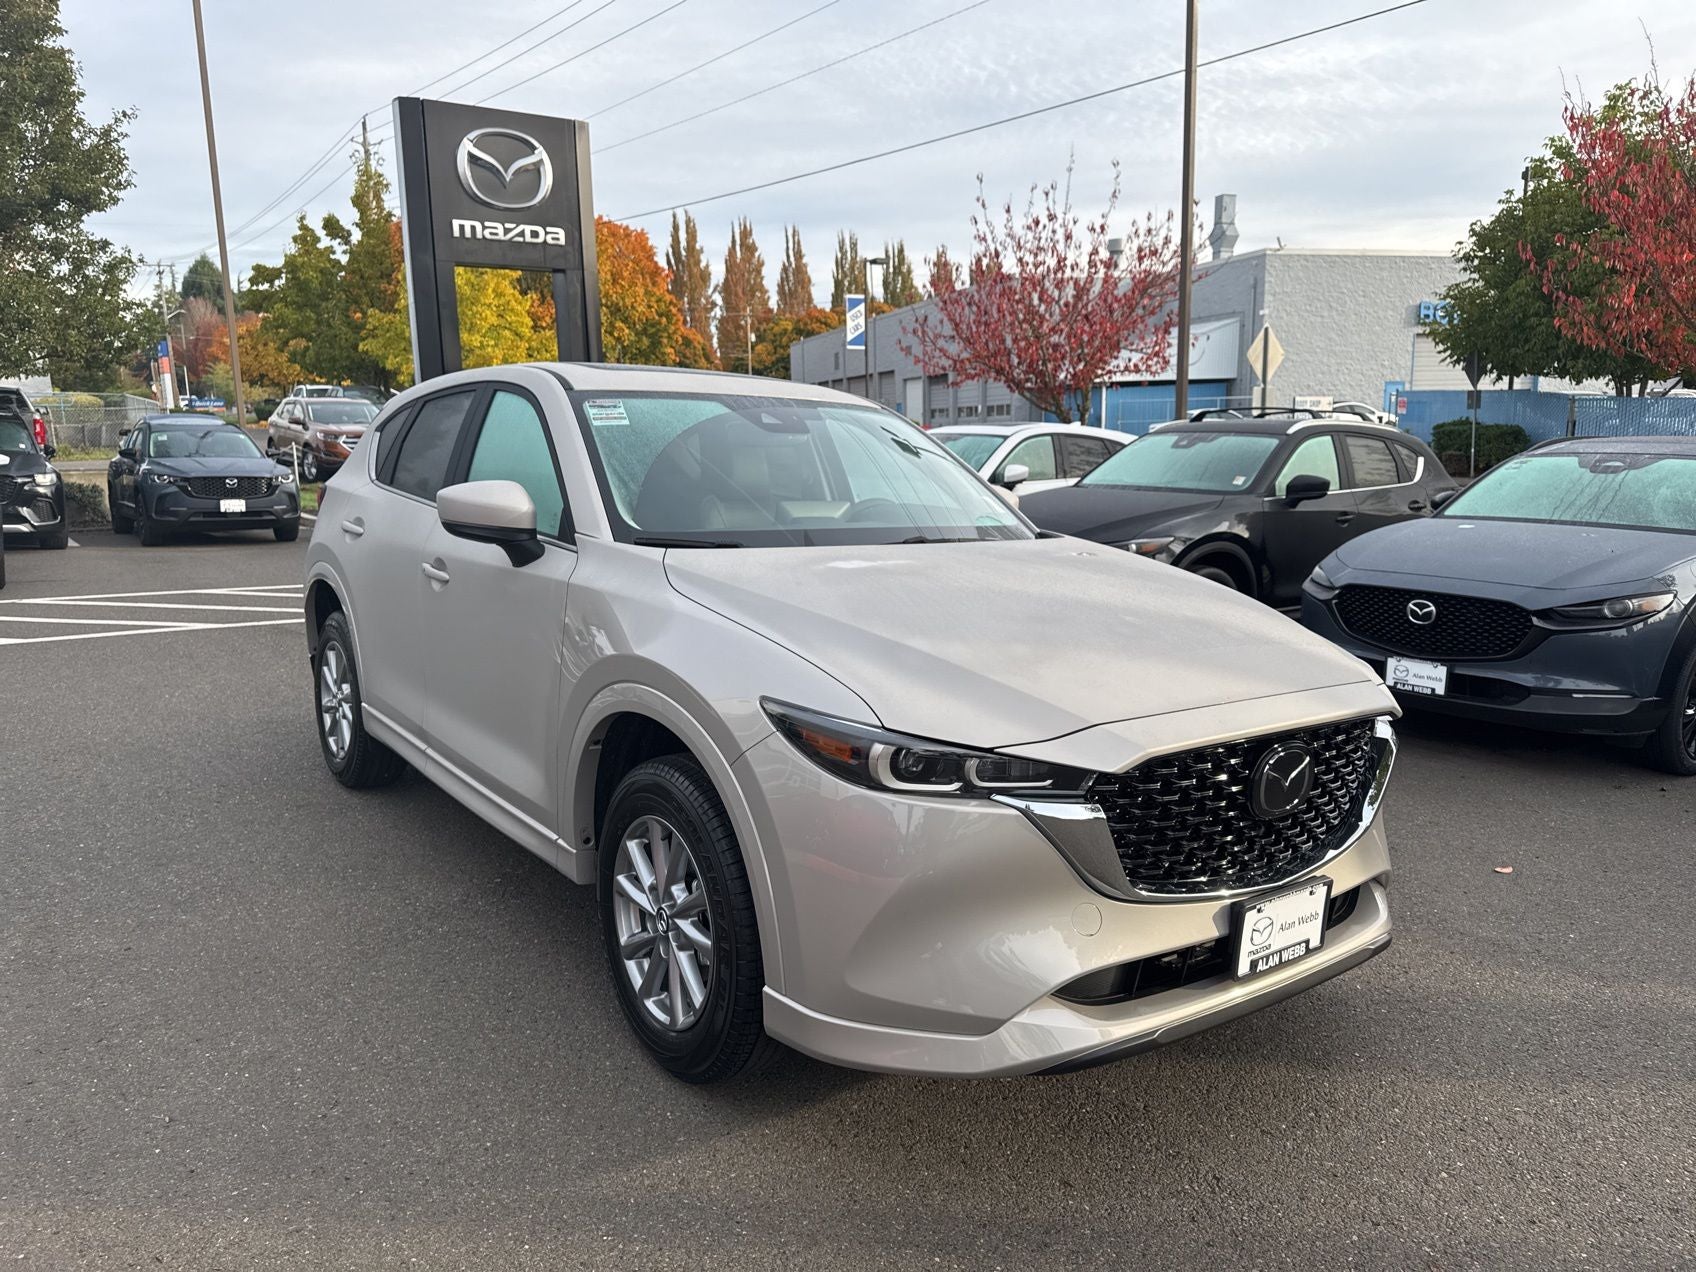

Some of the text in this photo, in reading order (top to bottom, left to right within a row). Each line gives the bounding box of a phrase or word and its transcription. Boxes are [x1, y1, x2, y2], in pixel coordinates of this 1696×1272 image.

[1396, 682, 1432, 695] ALAN WEBB
[1278, 910, 1320, 933] Alan Webb
[1256, 942, 1307, 973] ALAN WEBB
